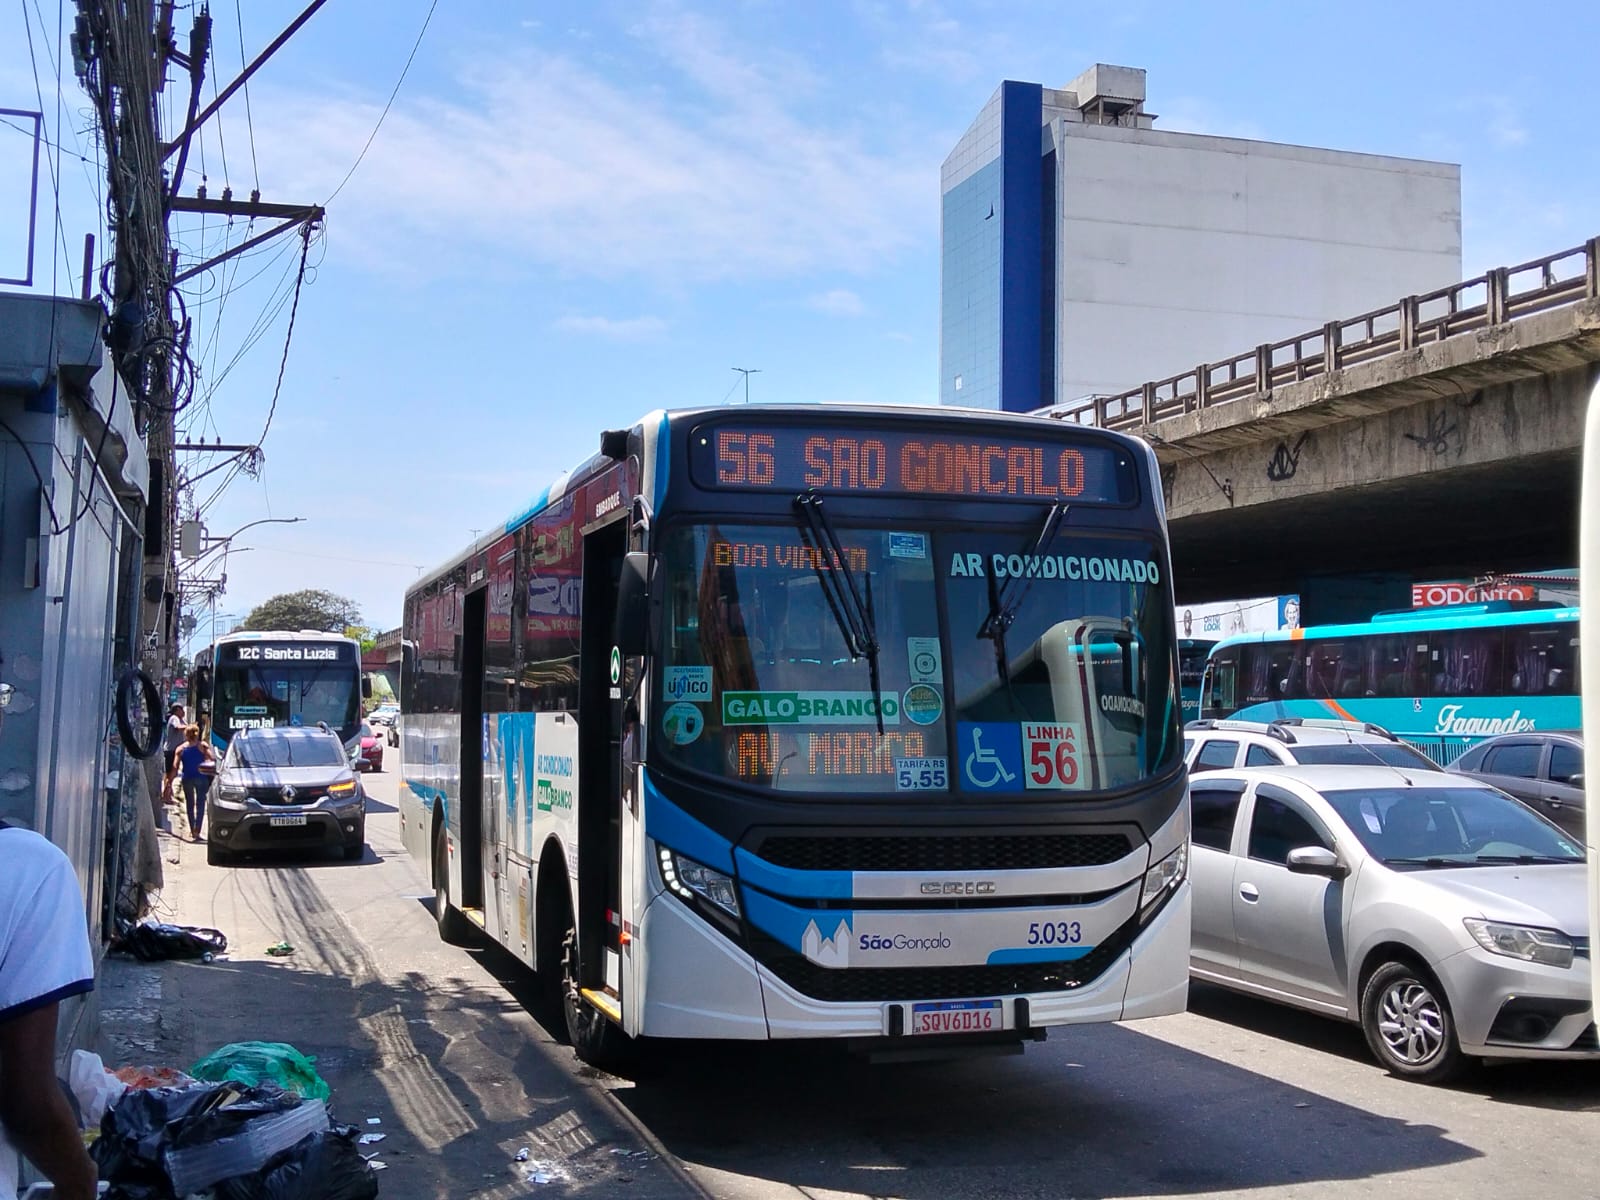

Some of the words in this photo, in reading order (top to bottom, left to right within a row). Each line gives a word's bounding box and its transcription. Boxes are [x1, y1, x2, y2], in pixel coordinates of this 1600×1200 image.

[718, 432, 775, 485] 56
[804, 436, 886, 489] SAO
[899, 440, 1085, 497] GONCALO
[714, 543, 768, 567] BOA
[951, 553, 984, 577] AR
[992, 554, 1159, 585] CONDICIONADO
[239, 647, 260, 660] 12C
[264, 647, 302, 660] Santa
[303, 647, 336, 660] Luzia
[668, 675, 708, 697] ÚNICO
[1027, 726, 1075, 740] LINHA
[1435, 704, 1536, 742] Fagundes
[809, 731, 925, 775] MARICA
[898, 760, 930, 769] TARIFA
[1031, 742, 1079, 785] 56
[899, 770, 946, 788] 5,55
[1027, 921, 1081, 945] 5.033
[922, 1011, 992, 1032] SQV6D16
